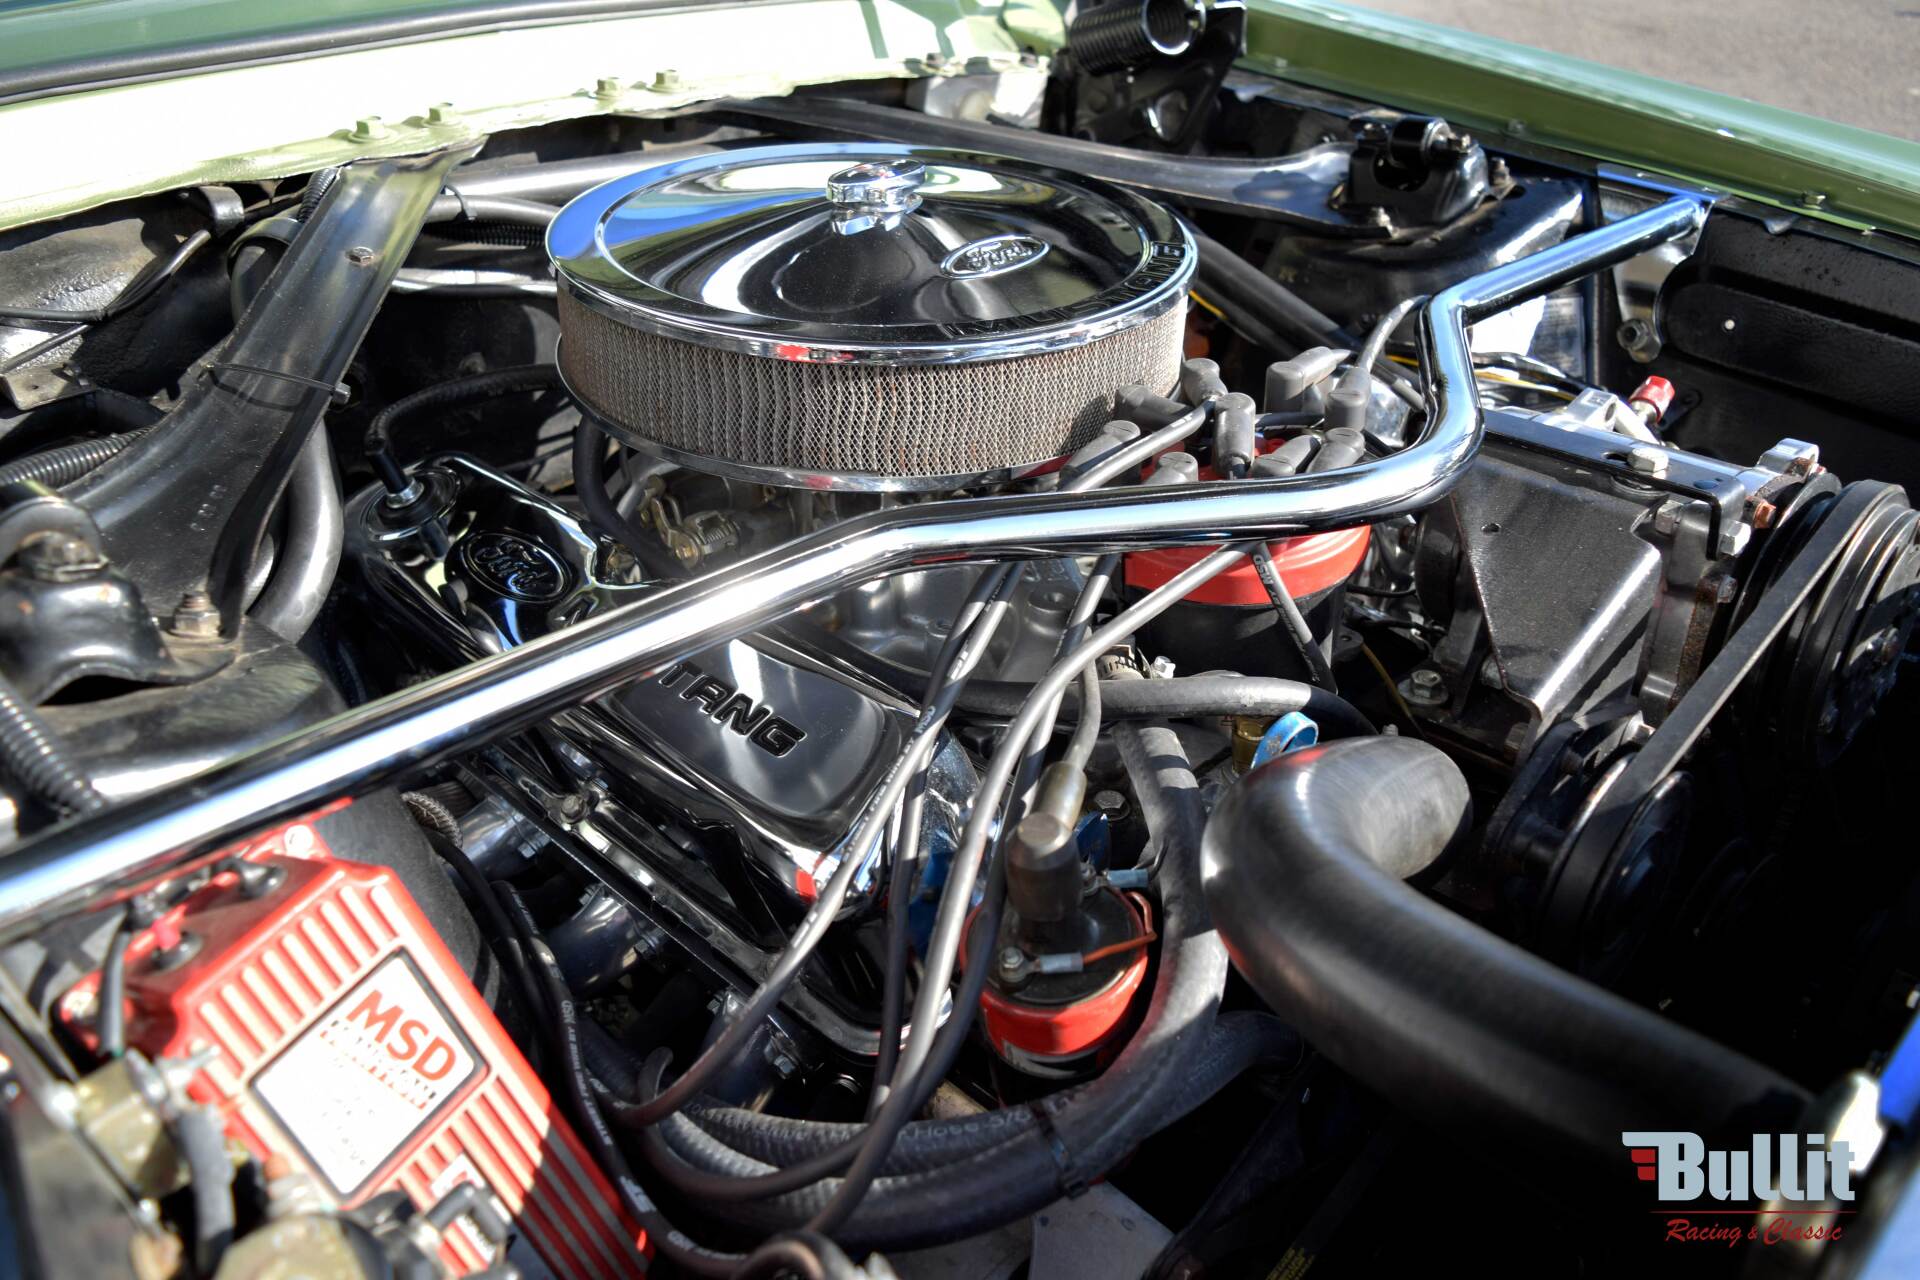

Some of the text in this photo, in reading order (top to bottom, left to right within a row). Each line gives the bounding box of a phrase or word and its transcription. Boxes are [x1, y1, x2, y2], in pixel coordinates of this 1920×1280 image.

[965, 240, 1033, 273] Ford
[941, 241, 1188, 339] MUSTANG
[474, 535, 554, 591] Ford
[1254, 554, 1275, 585] MSD
[659, 661, 808, 758] TANG
[914, 705, 937, 734] MSD
[561, 1000, 577, 1024] MSD
[345, 990, 457, 1081] MSD
